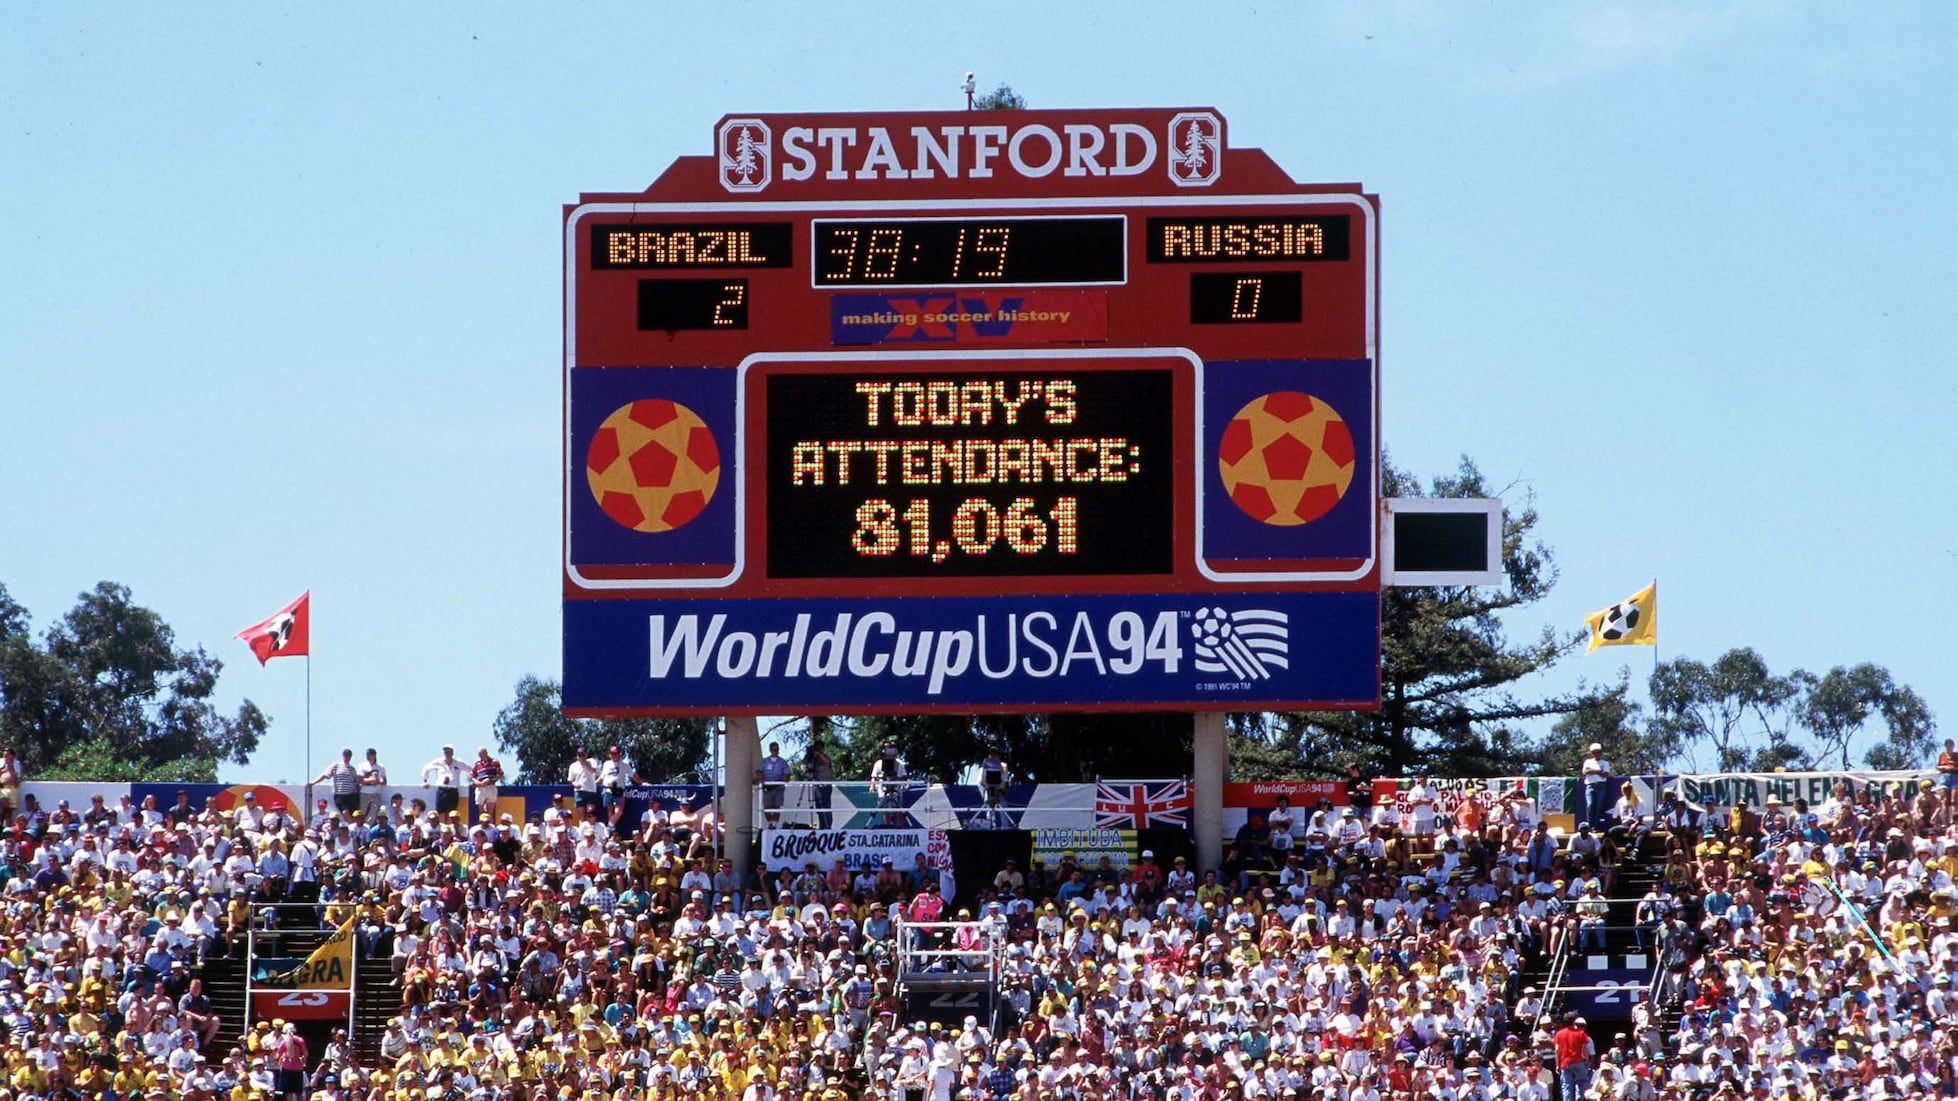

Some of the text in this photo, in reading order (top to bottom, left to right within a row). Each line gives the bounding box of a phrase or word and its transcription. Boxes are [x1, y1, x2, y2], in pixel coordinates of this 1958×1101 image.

[782, 124, 1157, 181] STANFORD
[609, 231, 766, 263] BRAZIL
[1164, 223, 1323, 257] RUSSIA
[713, 285, 744, 325] 2
[1231, 278, 1262, 319] 0
[842, 309, 1071, 326] making soccer history
[856, 379, 1077, 426] TODAY'S
[793, 438, 1140, 485] ATTENDANCE:
[852, 497, 1077, 563] 81,061
[649, 610, 1183, 694] WorldCupUSA94
[1253, 783, 1321, 795] WorldCupUSA94
[1684, 777, 1760, 806] SANTA
[772, 831, 847, 859] BRUSQUE
[1036, 828, 1122, 848] IMBITUBA
[844, 853, 888, 868] BRASI
[1595, 980, 1640, 1003] 21
